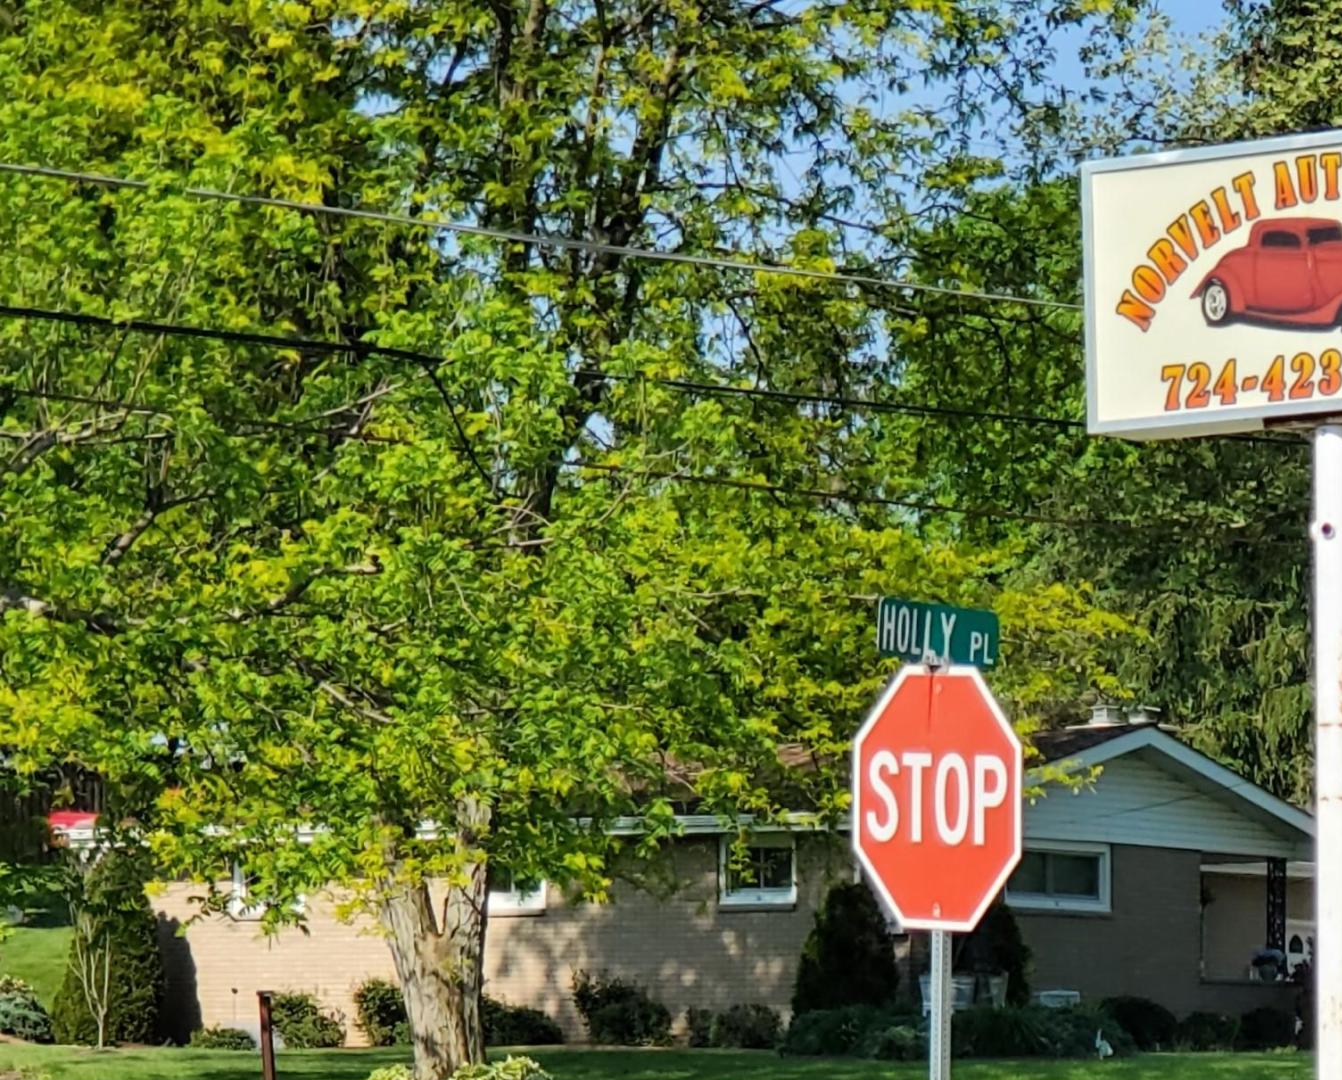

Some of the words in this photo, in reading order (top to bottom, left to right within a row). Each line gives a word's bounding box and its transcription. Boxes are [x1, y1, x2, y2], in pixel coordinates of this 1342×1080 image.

[1116, 170, 1260, 332] NORVELT
[882, 603, 957, 660] HOLLY
[969, 631, 994, 665] PL
[866, 750, 1008, 846] STOP
